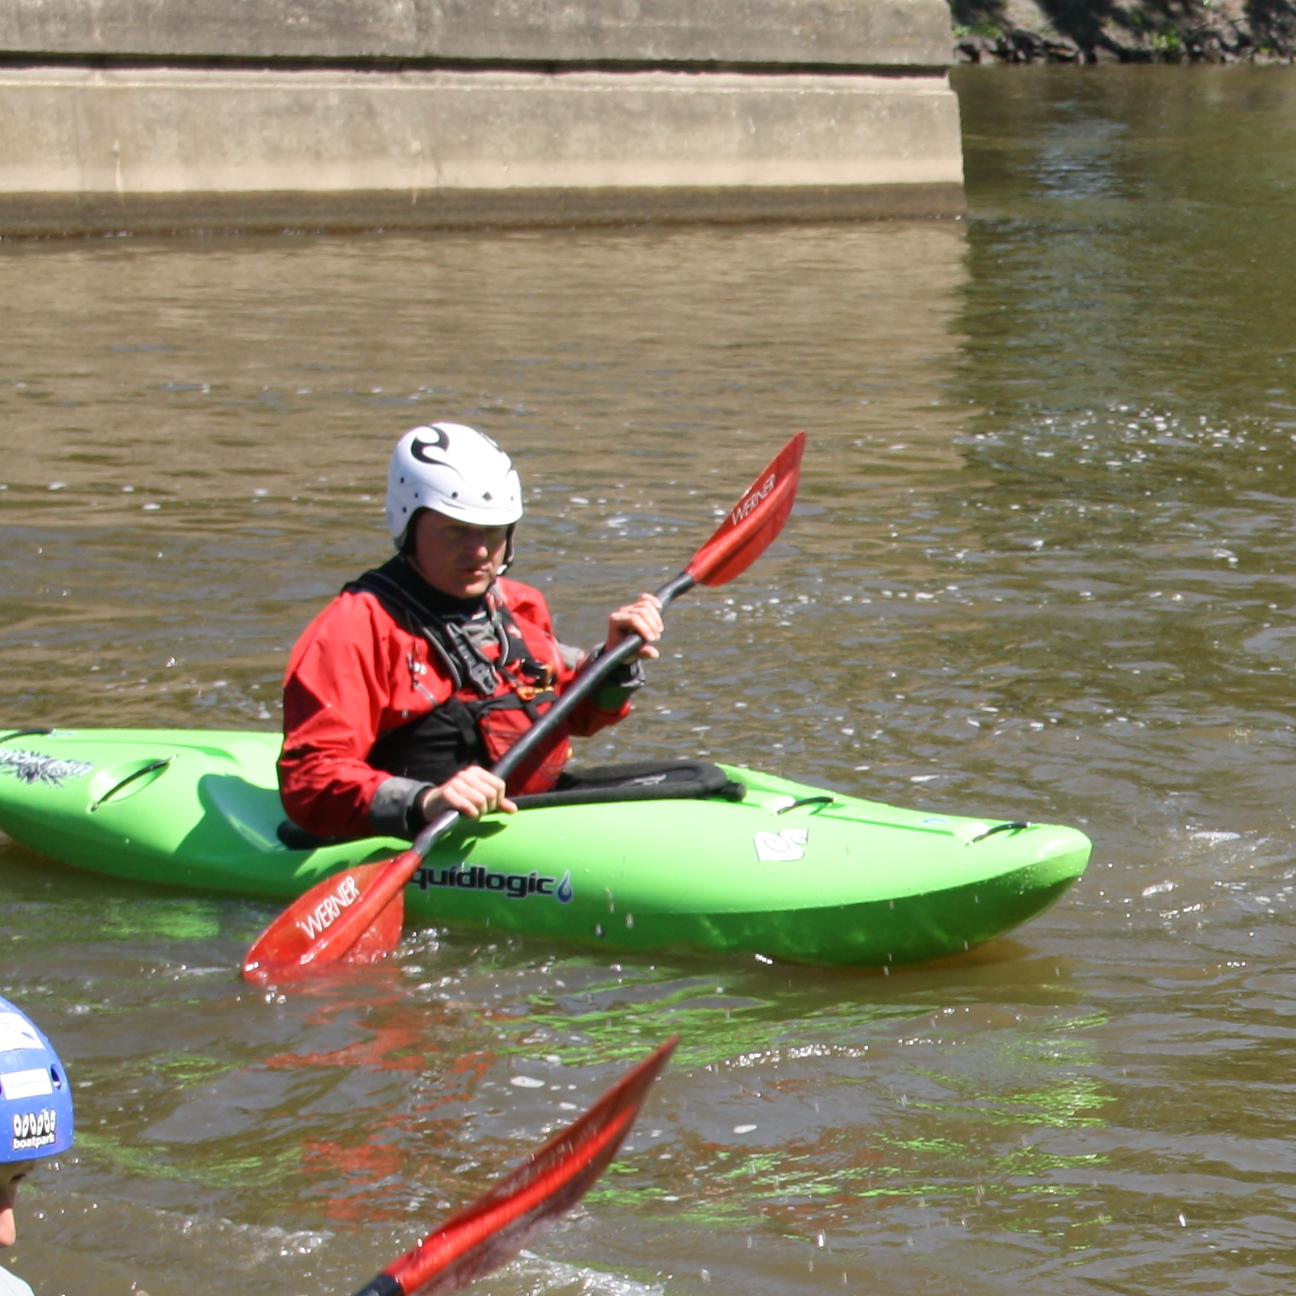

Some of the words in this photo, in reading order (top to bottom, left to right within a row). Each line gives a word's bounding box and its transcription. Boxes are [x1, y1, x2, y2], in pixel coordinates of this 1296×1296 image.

[731, 473, 777, 526] WERNER
[405, 865, 557, 898] quidlogic
[299, 875, 362, 940] WERNER
[12, 1132, 56, 1150] boatpark
